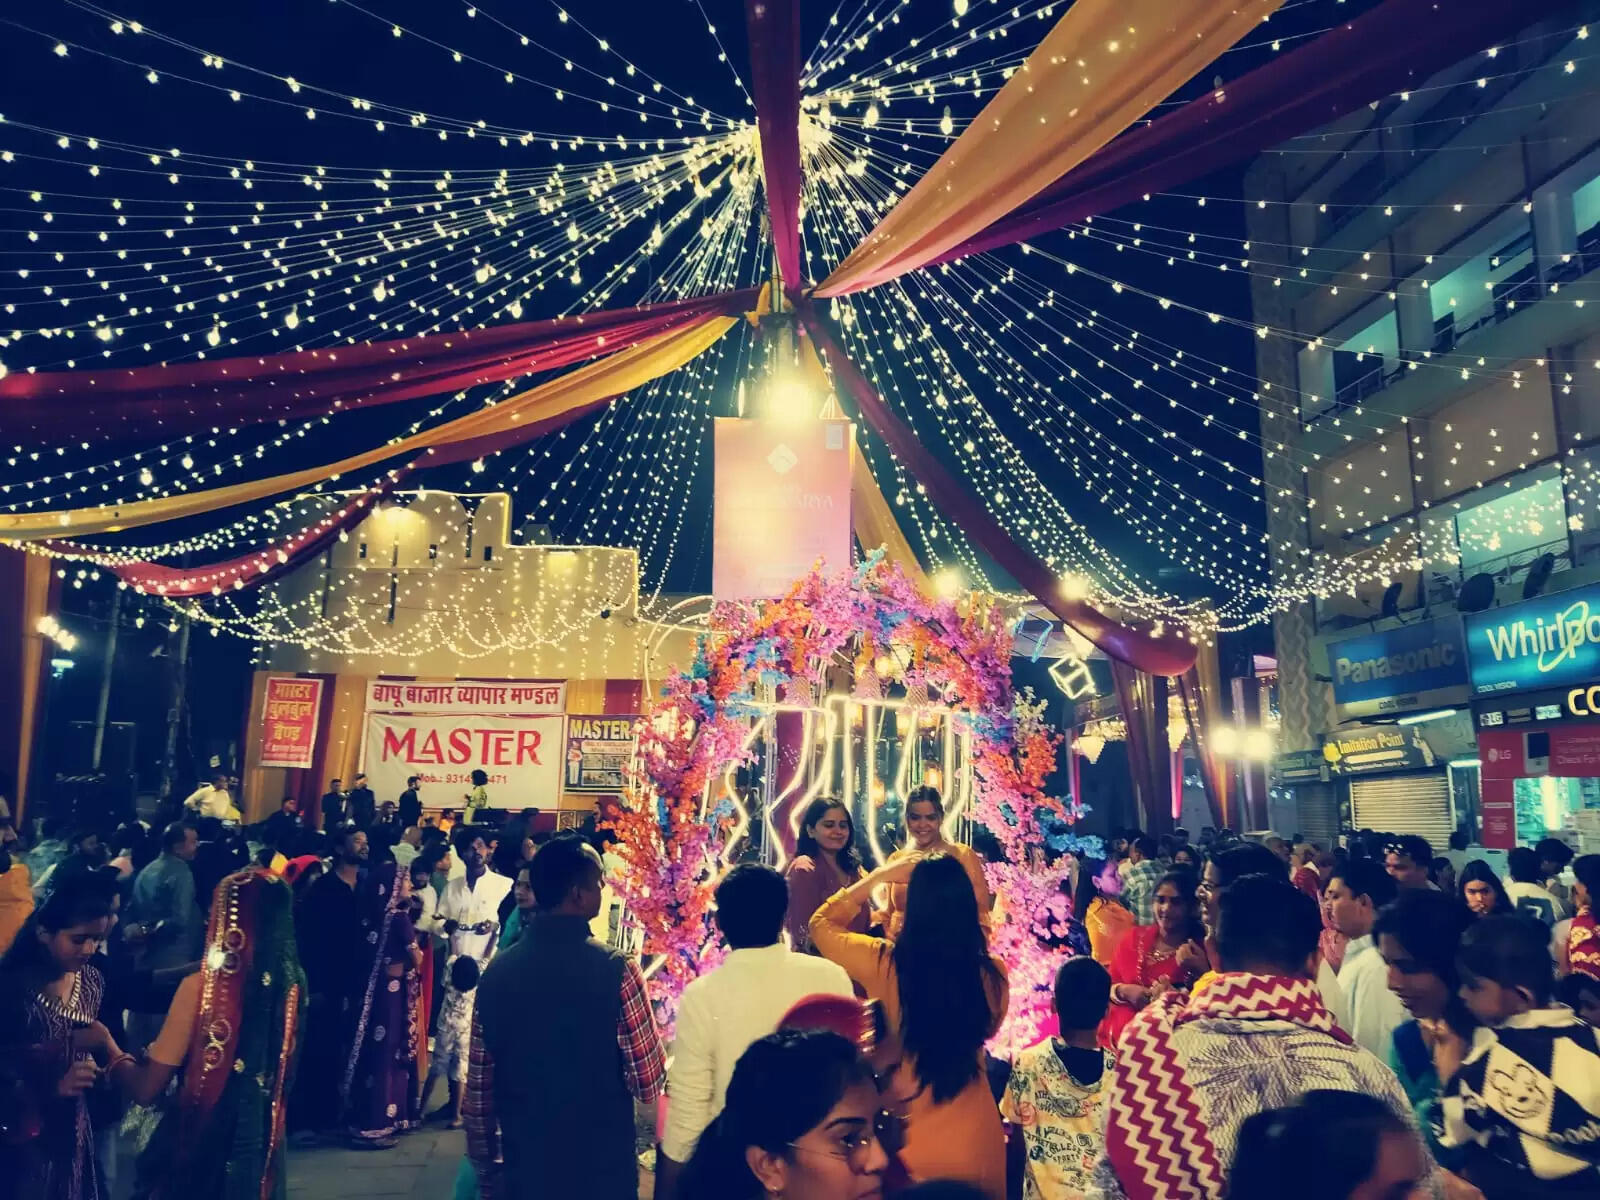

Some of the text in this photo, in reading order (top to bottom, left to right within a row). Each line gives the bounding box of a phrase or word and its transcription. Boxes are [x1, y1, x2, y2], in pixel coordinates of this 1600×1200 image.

[1335, 640, 1456, 685] Panasonic
[373, 684, 561, 707] बापू बाजार व्यापार मण्डल
[569, 718, 631, 740] MASTER
[1376, 731, 1405, 748] Point
[382, 726, 543, 766] MASTER
[1499, 749, 1512, 760] LG
